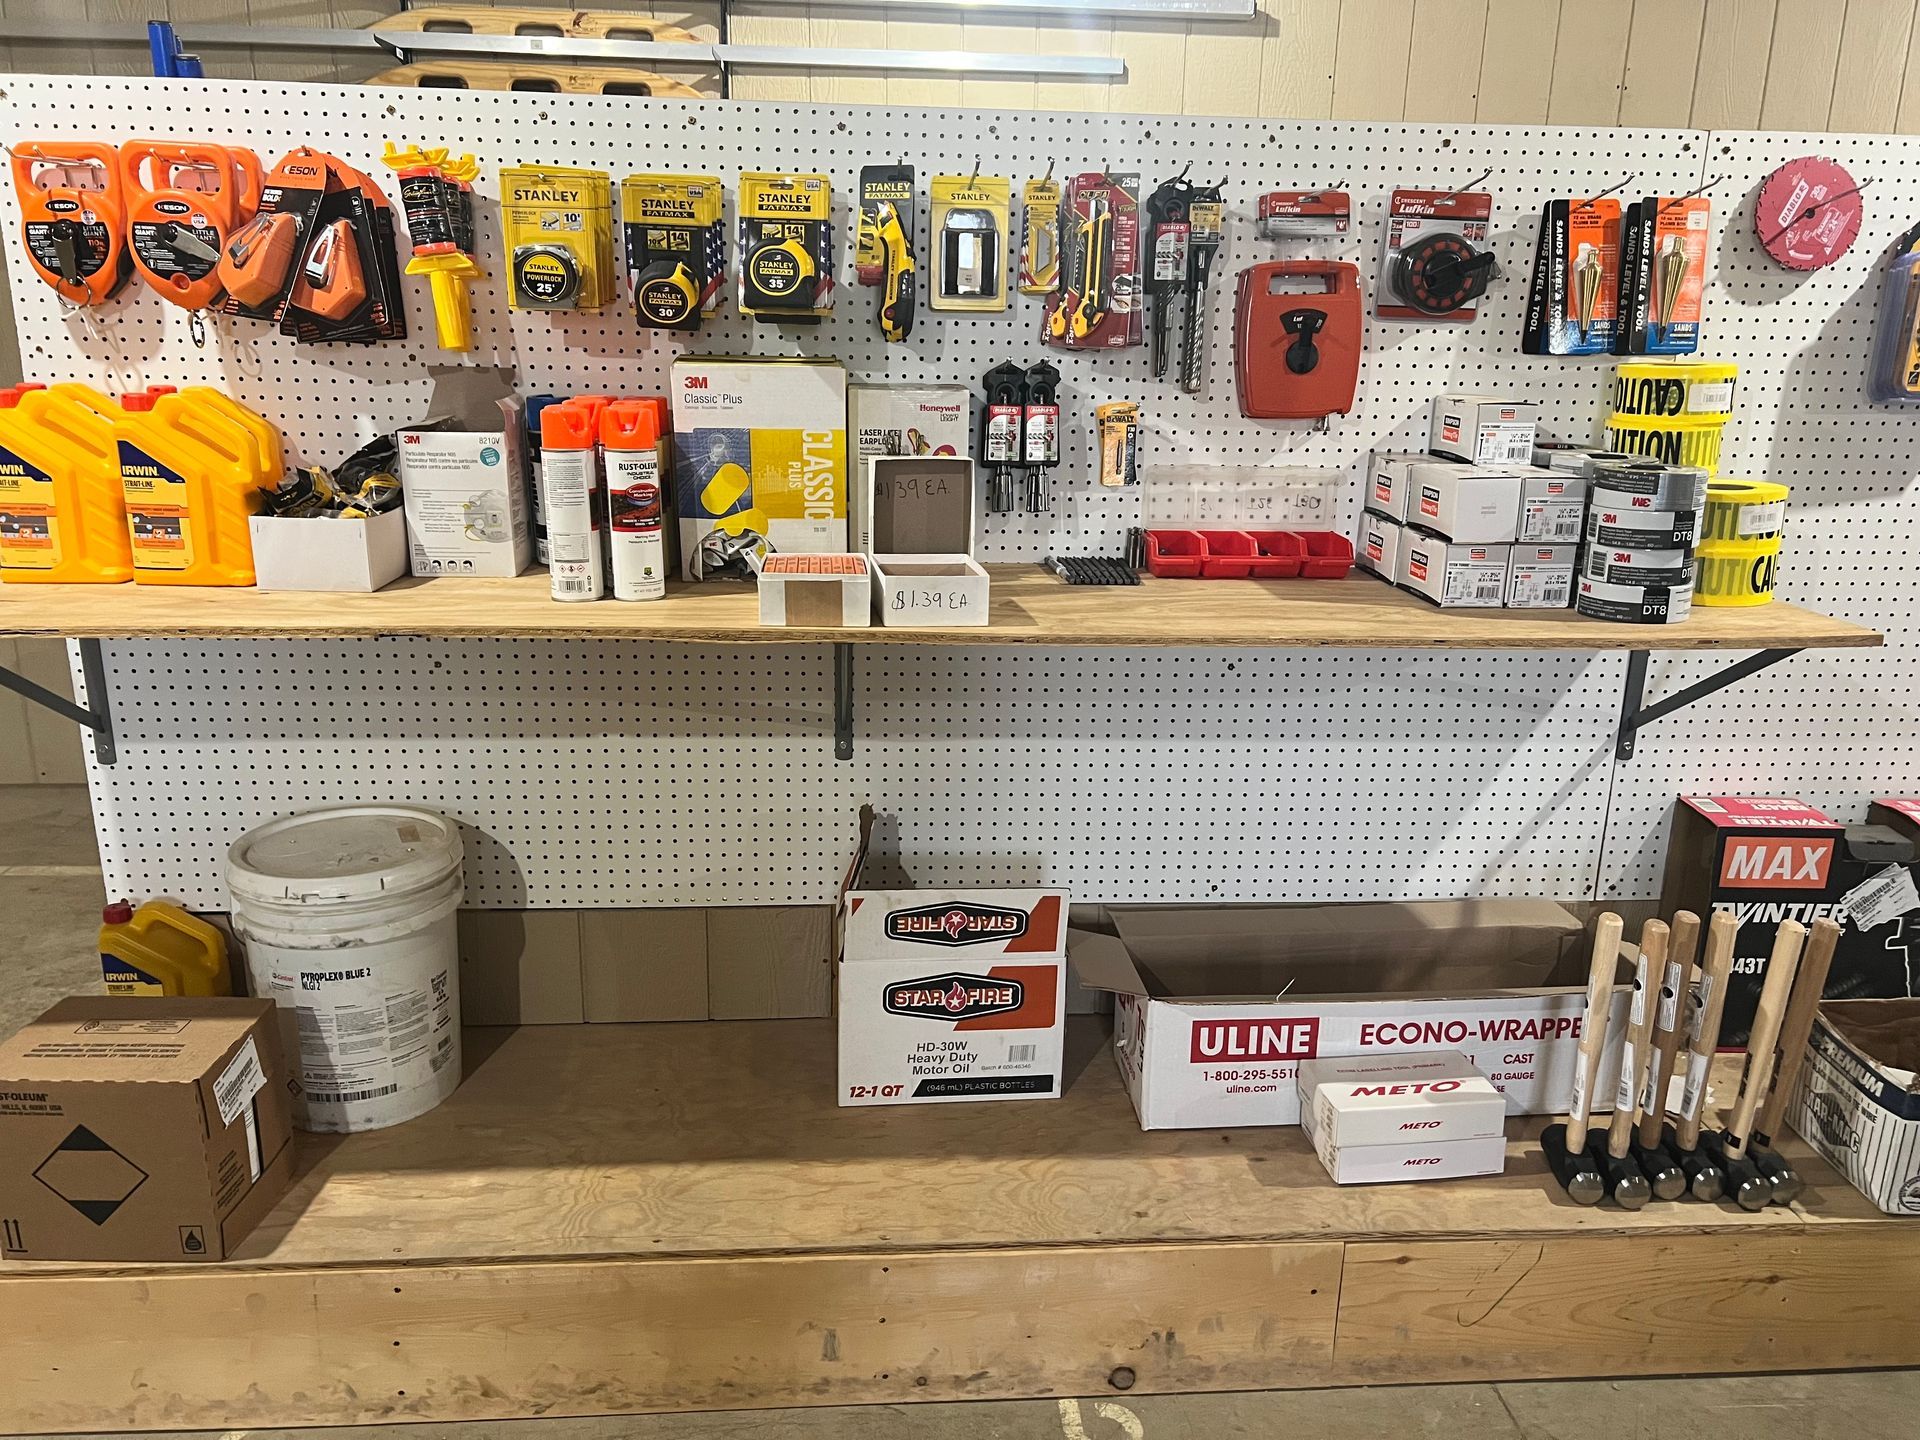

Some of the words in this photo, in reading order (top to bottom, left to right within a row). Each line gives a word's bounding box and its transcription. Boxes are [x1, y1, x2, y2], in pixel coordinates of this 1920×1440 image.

[281, 165, 318, 176] KESON
[864, 182, 911, 191] STANLEY
[514, 190, 579, 202] STANLEY
[758, 193, 811, 204] STANLEY
[950, 193, 990, 201] STANLEY
[641, 199, 695, 210] STANLEY
[762, 204, 805, 212] FATMAX
[1399, 204, 1435, 214] Lufkin
[1781, 192, 1802, 224] DIABLO
[646, 210, 689, 218] FATMAX
[1555, 219, 1564, 256] SANDS
[1642, 219, 1651, 256] SANDS
[1626, 225, 1638, 262] SANDS
[528, 263, 559, 272] STANLEY
[759, 261, 794, 269] STANLEY
[759, 268, 794, 276] FATMAX
[1535, 260, 1547, 291] LEVEL
[1555, 258, 1564, 290] LEVEL
[1639, 259, 1649, 291] LEVEL
[526, 273, 563, 283] POWERLOCK
[1621, 265, 1632, 295] LEVEL
[648, 291, 682, 300] STANLEY
[1637, 293, 1645, 302] &
[1529, 305, 1540, 333] TOOL
[1616, 310, 1627, 336] TOOL
[1635, 305, 1645, 333] TOOL
[1674, 323, 1693, 332] SANDS
[684, 376, 708, 389] 3M
[722, 394, 743, 404] Plus
[1613, 376, 1685, 417] CAUTIO
[919, 404, 961, 413] Honeywell
[859, 428, 883, 437] LASER
[403, 435, 420, 445] 3M
[479, 437, 500, 445] 8210V
[1610, 428, 1682, 465] UTION
[0, 464, 25, 475] WIN
[122, 465, 159, 477] IRWIN
[788, 461, 802, 489] PLUS
[802, 430, 834, 521] CLASSIC
[124, 479, 155, 488] STRAIT-LINE
[1632, 496, 1652, 508] 3M
[1602, 513, 1617, 524] 3M
[1673, 531, 1693, 542] DT8
[1613, 552, 1631, 564] 3M
[1581, 582, 1592, 593] 3M
[891, 589, 942, 611] $1.39
[1642, 605, 1667, 616] DT8
[1726, 845, 1828, 881] MAX
[896, 918, 946, 934] FIRE
[967, 916, 1018, 933] STAR
[105, 972, 138, 981] IRWIN
[345, 970, 365, 980] BLUE
[366, 967, 371, 977] 2
[302, 981, 315, 991] NLGI
[316, 982, 321, 991] 2
[894, 989, 944, 1008] STAR
[966, 988, 1014, 1006] FIRE
[1360, 1017, 1583, 1045] ECONO-WRAPPE
[1200, 1024, 1312, 1056] ULINE
[916, 1041, 968, 1052] HD-30W
[907, 1053, 946, 1064] Heavy
[949, 1053, 979, 1064] Duty
[1503, 1053, 1535, 1065] CAST
[912, 1065, 948, 1076] Motor
[953, 1064, 970, 1074] Oil
[1820, 1035, 1884, 1098] PREMIUM
[1490, 1073, 1502, 1081] 80
[1504, 1071, 1535, 1080] GAUGE
[850, 1085, 878, 1097] 12-1
[881, 1085, 904, 1097] QT
[926, 1083, 945, 1092] (946
[947, 1082, 963, 1091] mL)
[964, 1082, 998, 1090] PLASTIC
[999, 1081, 1035, 1089] BOTTLES
[1226, 1083, 1277, 1094] uline.com
[1350, 1081, 1461, 1097] METO
[1399, 1121, 1442, 1131] METO
[1403, 1157, 1442, 1167] METO
